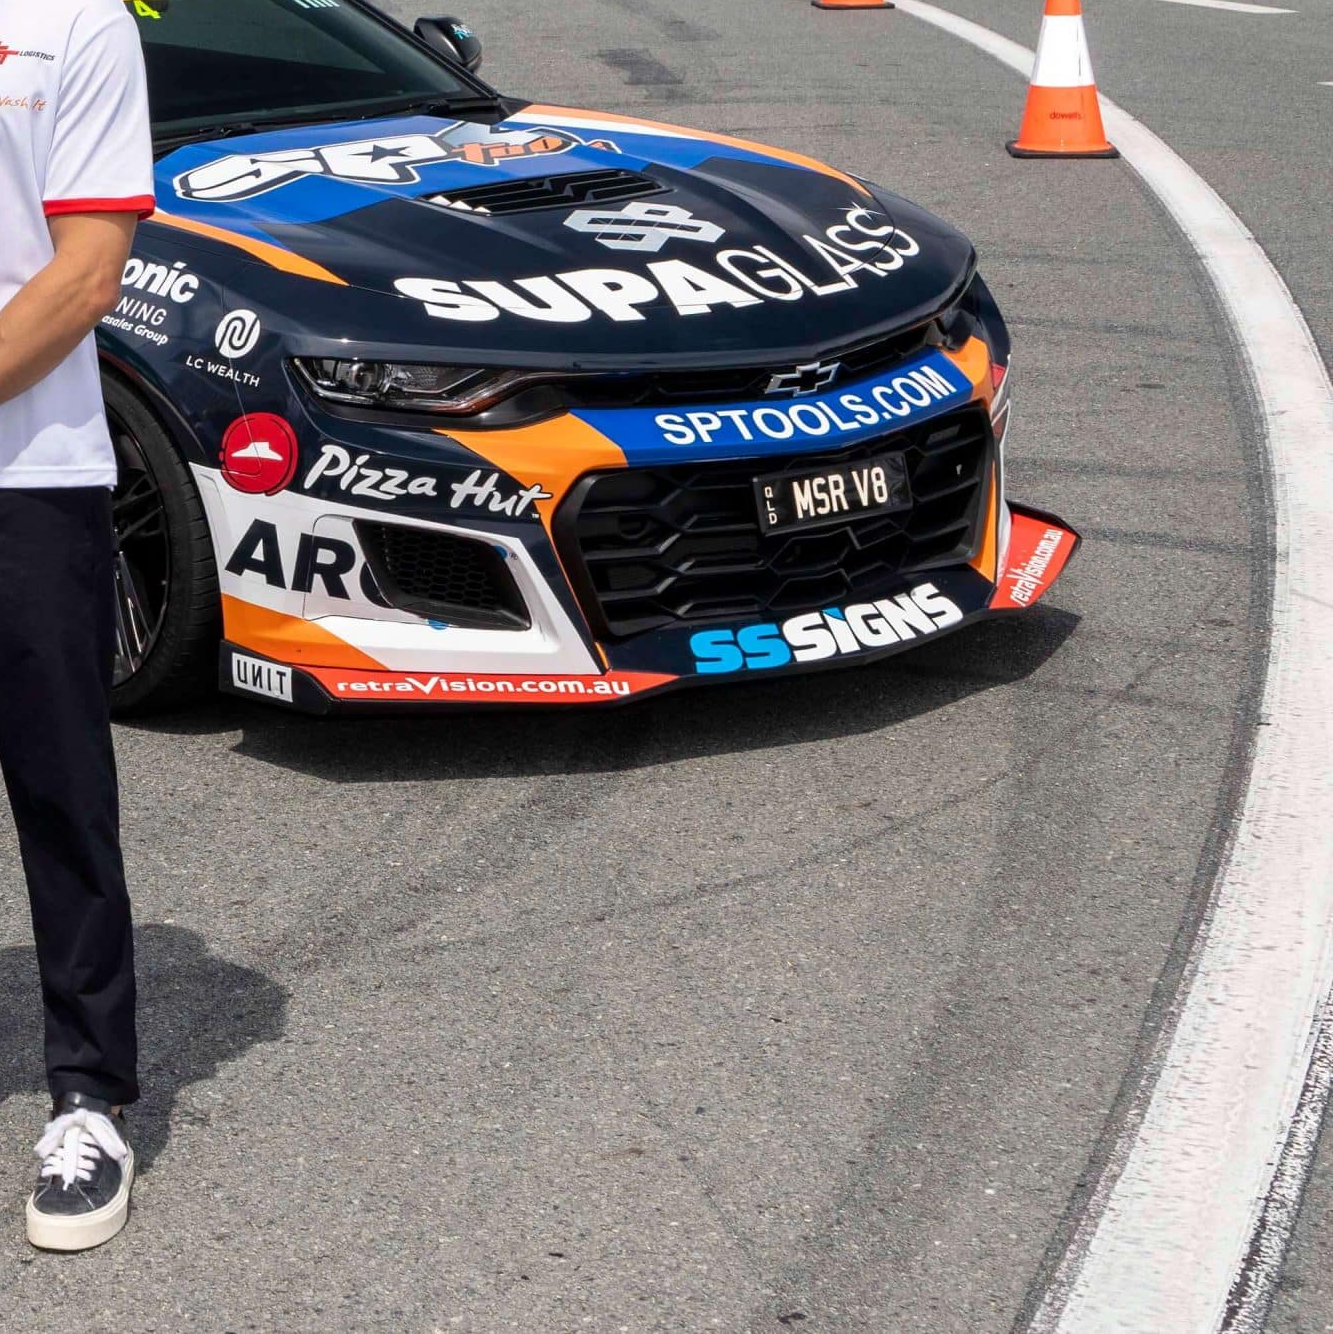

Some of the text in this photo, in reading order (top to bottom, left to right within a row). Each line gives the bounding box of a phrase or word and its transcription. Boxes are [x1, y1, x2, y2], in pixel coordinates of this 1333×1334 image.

[133, 324, 169, 347] Group
[185, 355, 261, 388] LC WEALTH
[654, 364, 959, 446] SPTOOLS.COM
[303, 443, 554, 516] Pizza Hut
[791, 466, 889, 519] MSR V8
[764, 485, 778, 525] QLD
[337, 674, 632, 696] retraVision.com.au
